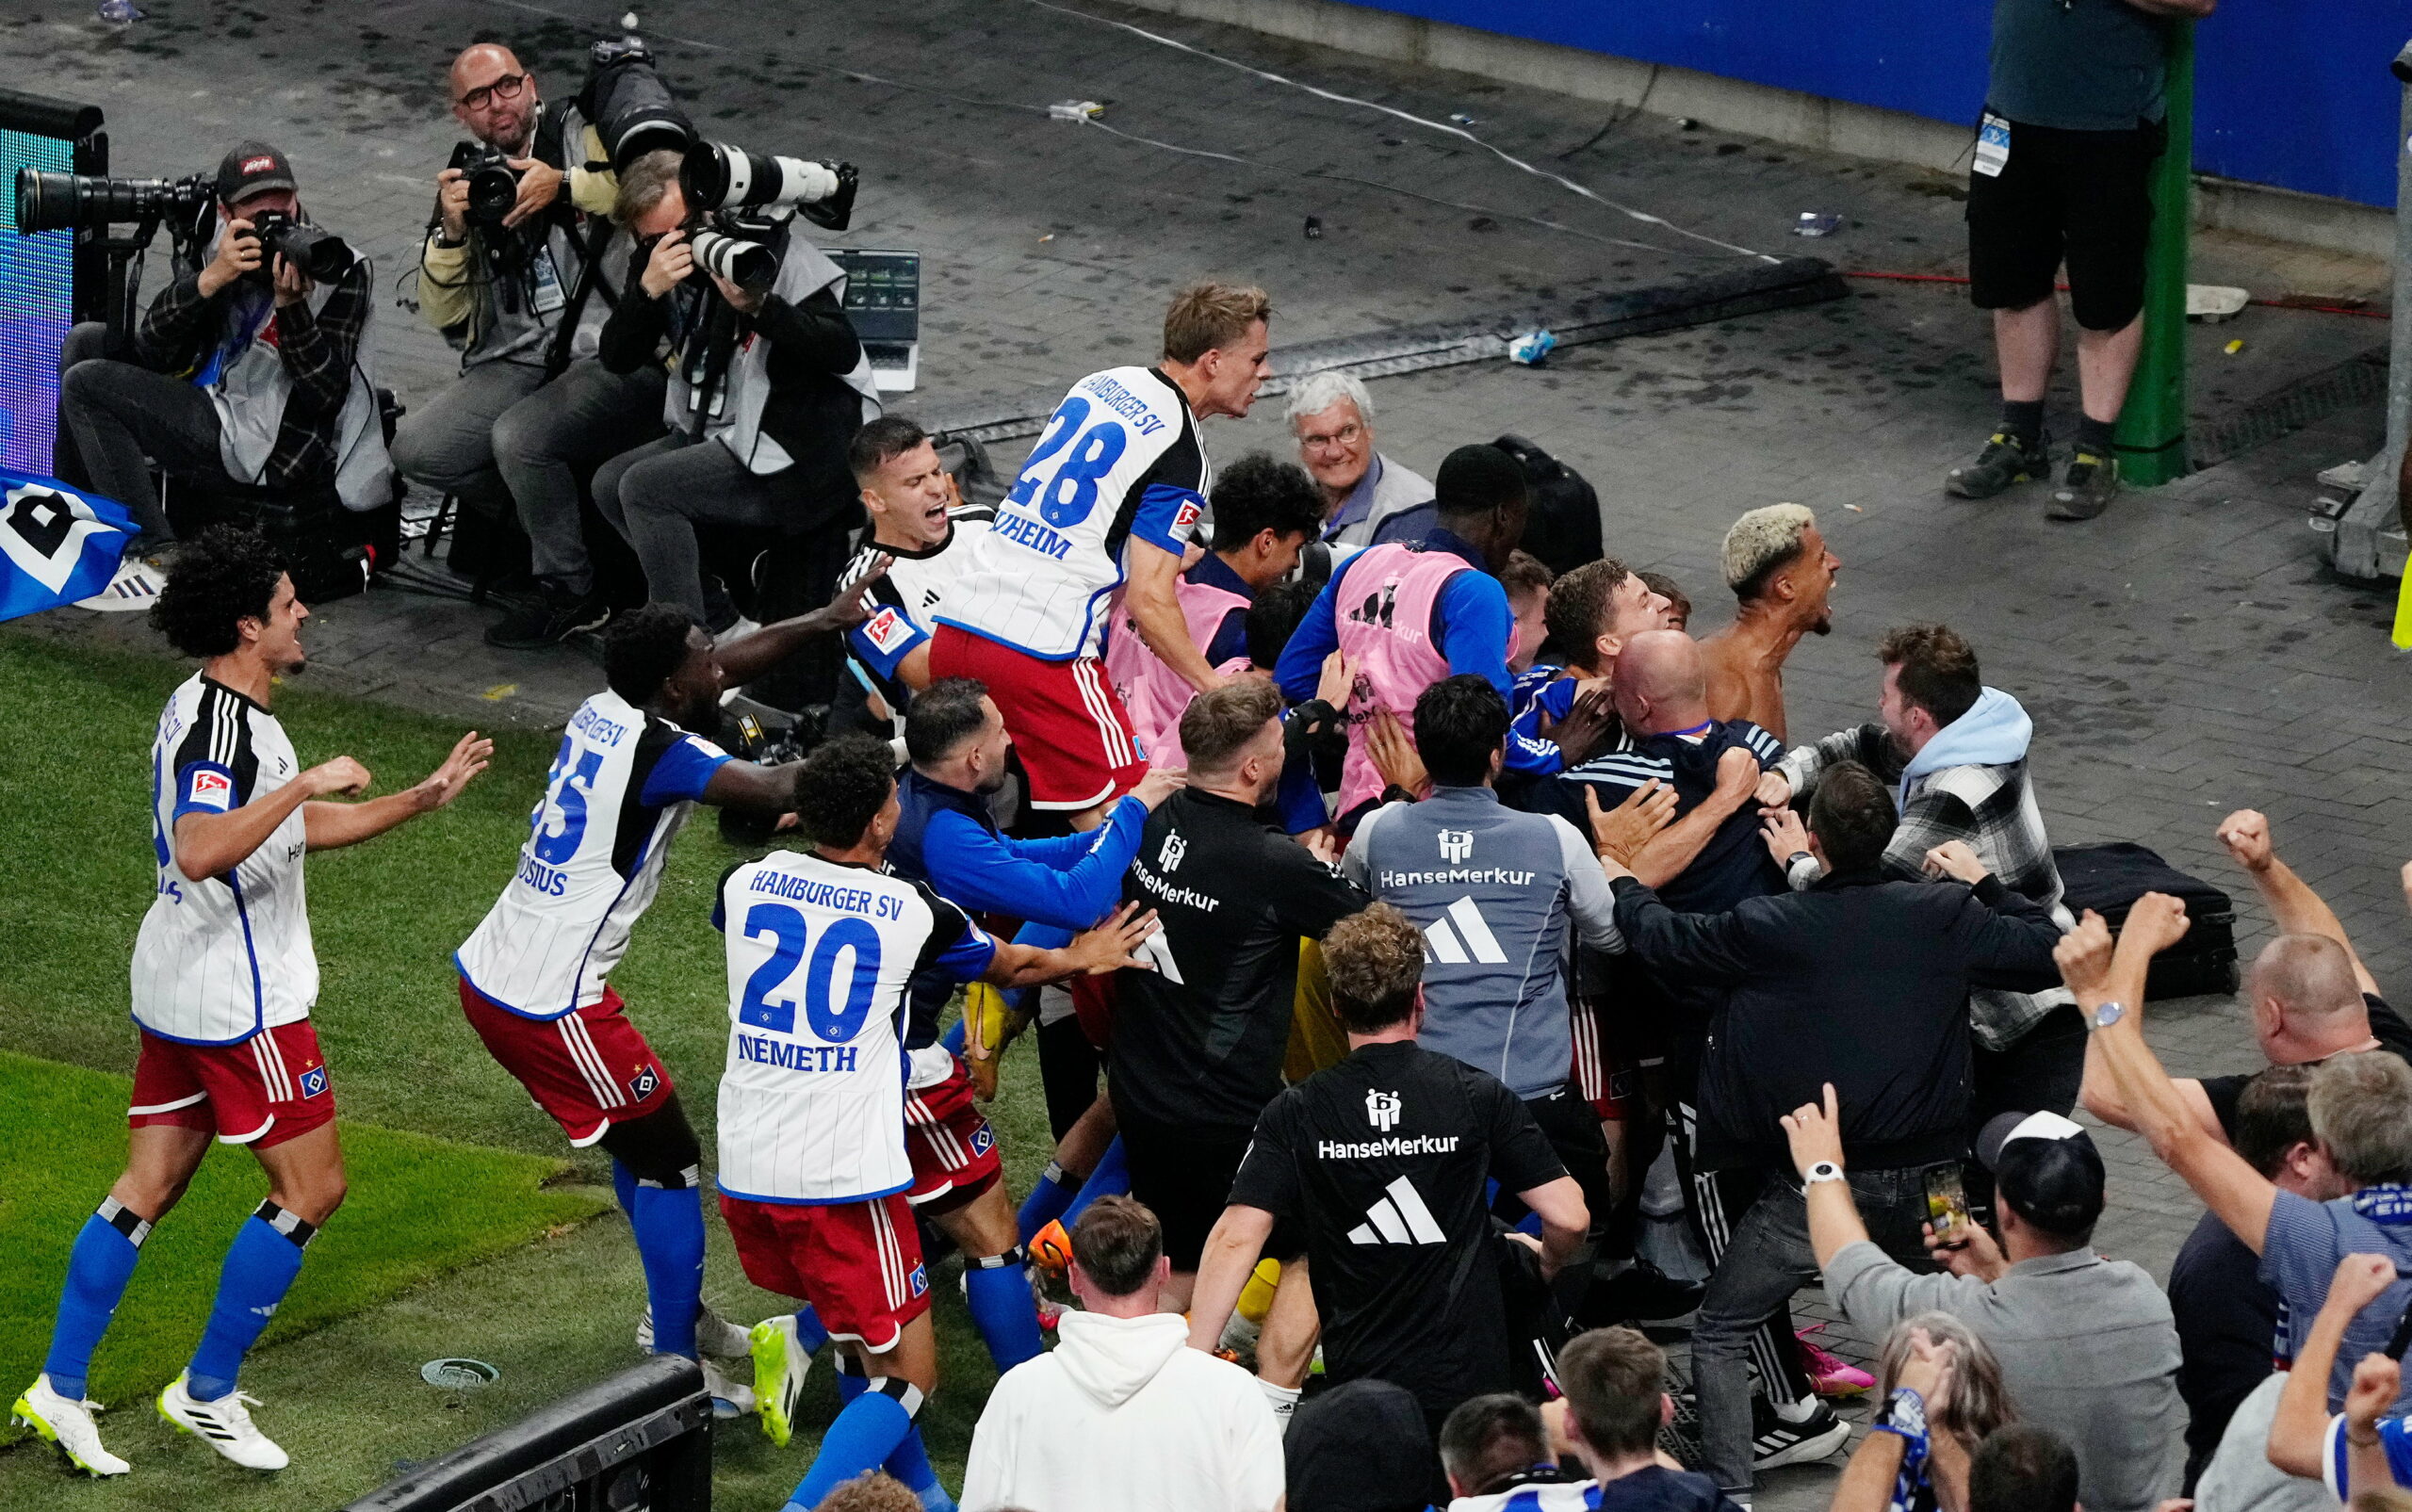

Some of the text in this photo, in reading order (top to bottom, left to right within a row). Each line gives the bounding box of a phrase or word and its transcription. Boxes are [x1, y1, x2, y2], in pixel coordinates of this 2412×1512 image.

[1134, 414, 1165, 436] SV
[1007, 397, 1127, 529] 28
[601, 723, 629, 747] SV
[750, 870, 904, 921] HAMBURGER SV
[1132, 855, 1219, 912] nseMerkur
[1380, 868, 1536, 888] HanseMerkur
[739, 902, 882, 1043] 20
[738, 1033, 858, 1072] NÉMETH
[1319, 1134, 1459, 1160] HanseMerkur
